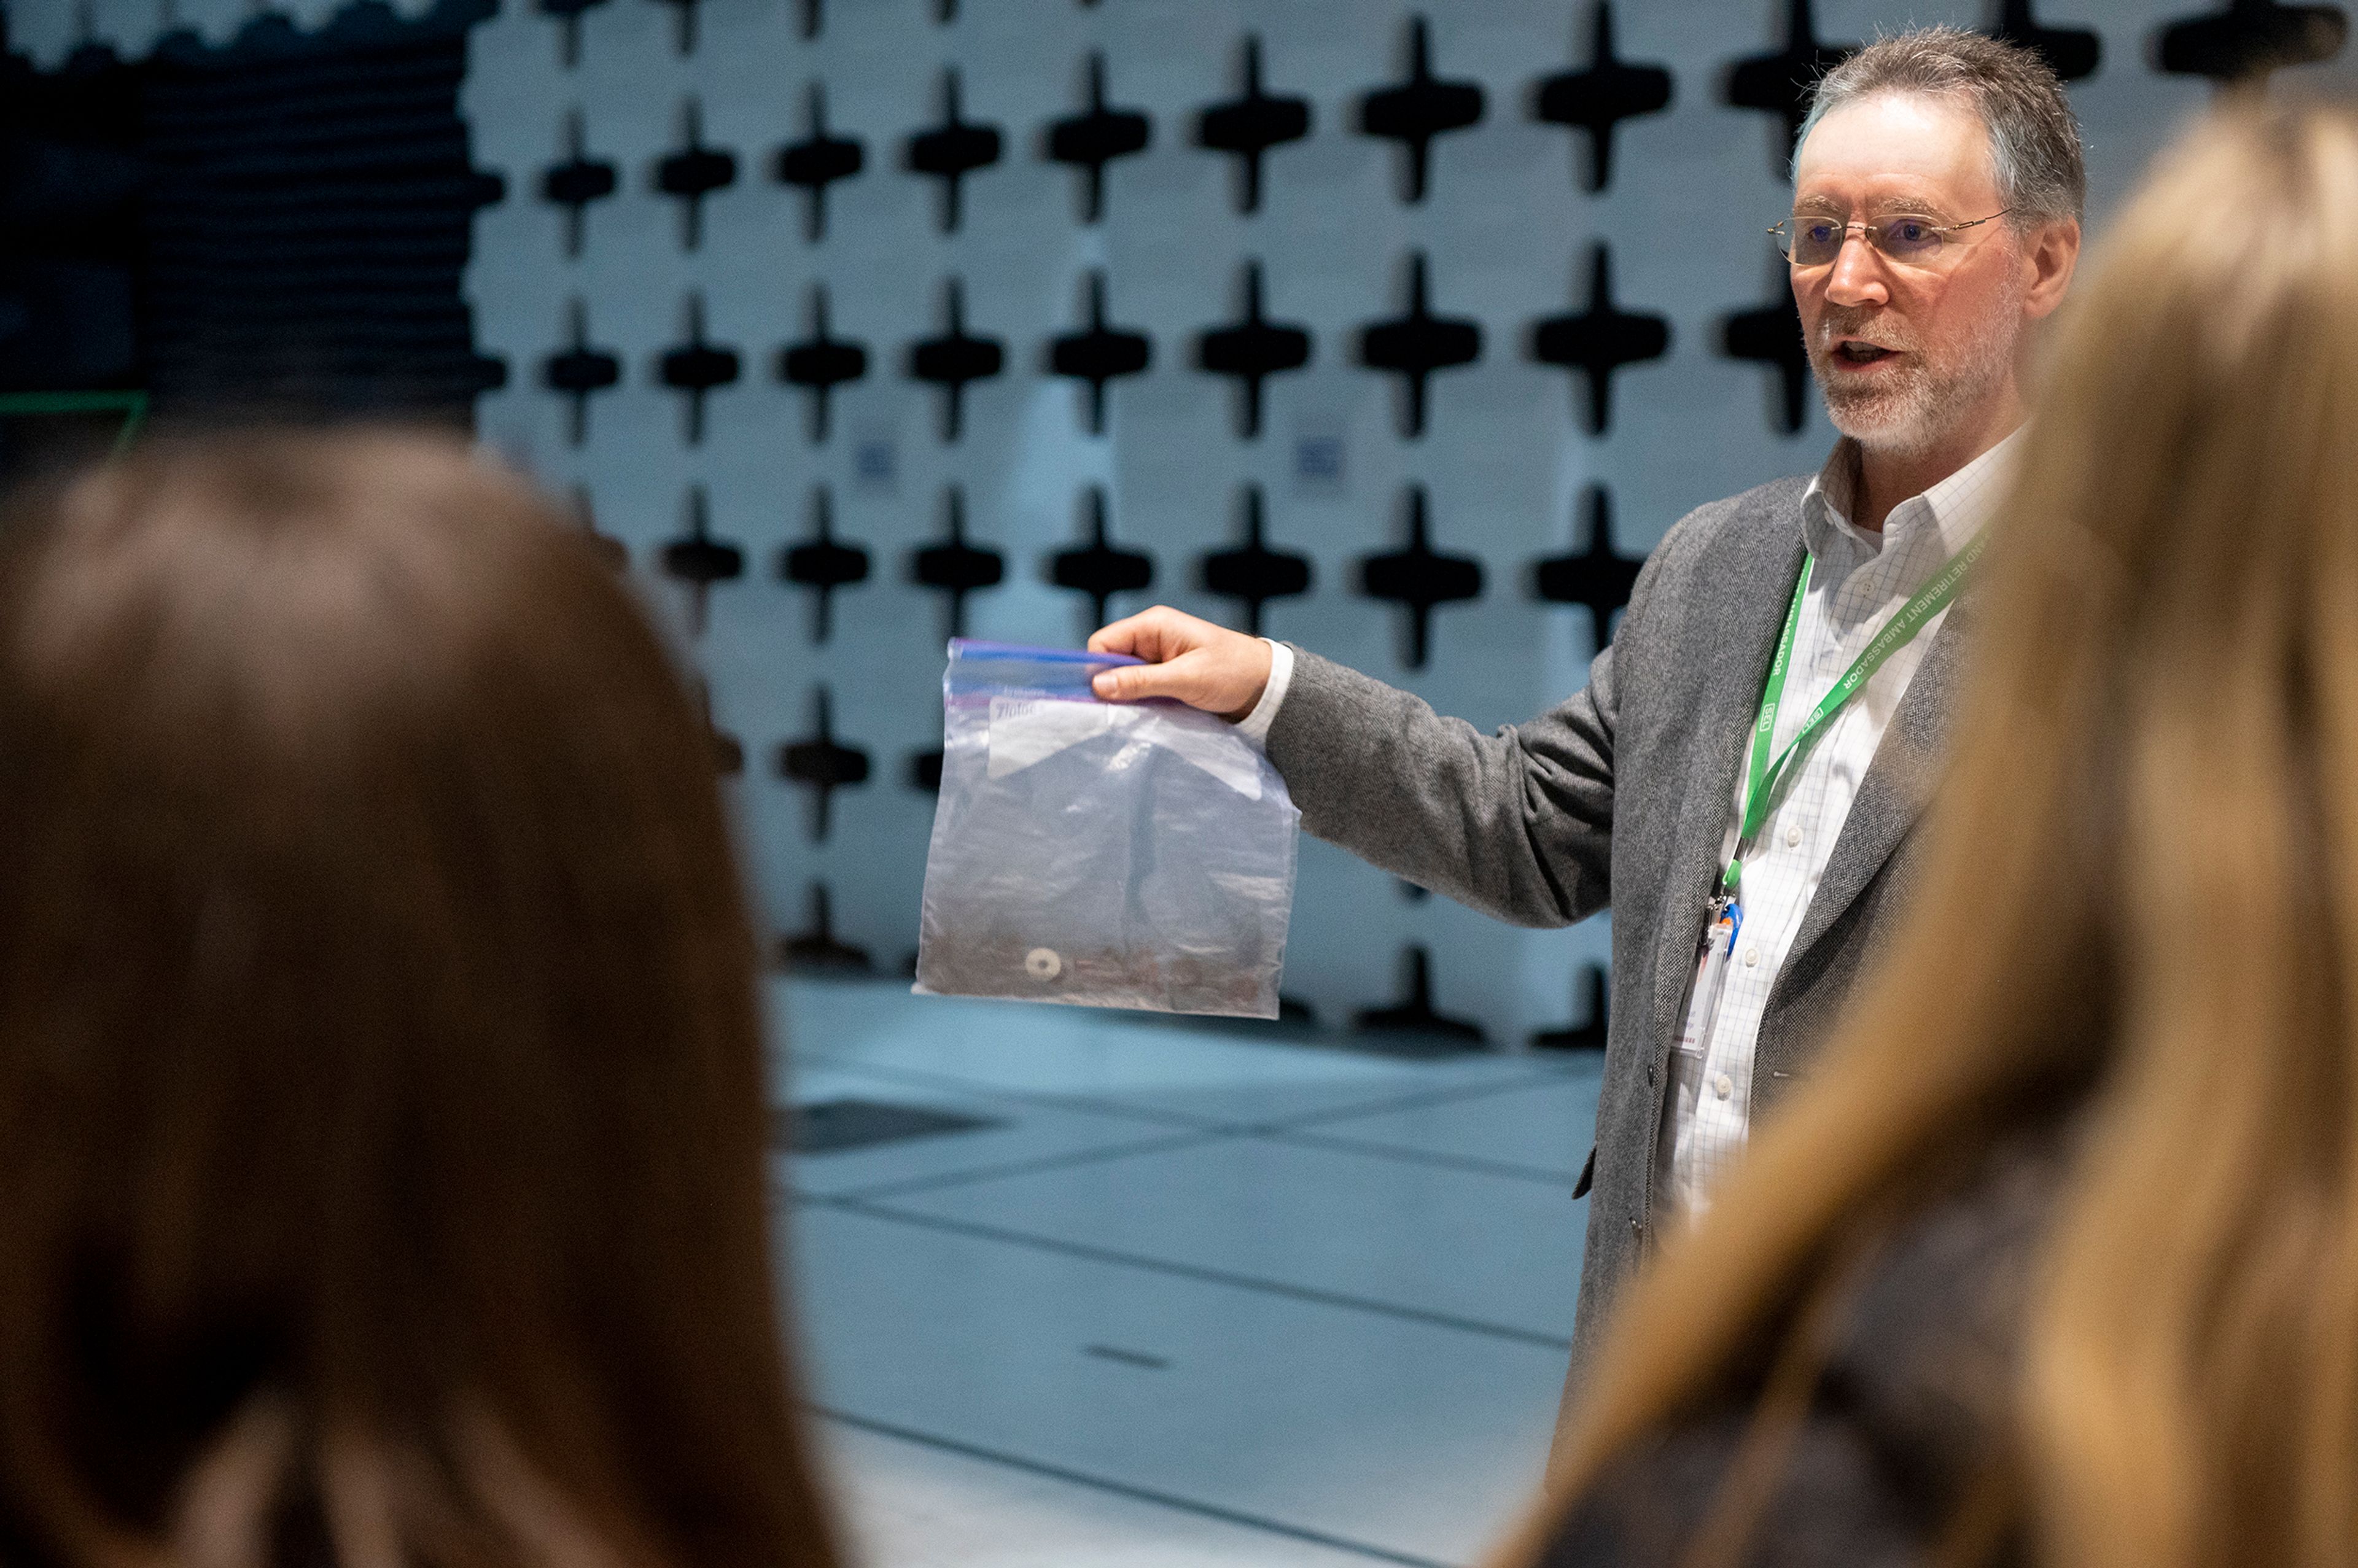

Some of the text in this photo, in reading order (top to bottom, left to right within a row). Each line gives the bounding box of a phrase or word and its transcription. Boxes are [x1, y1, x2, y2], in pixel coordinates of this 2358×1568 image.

[1905, 561, 1967, 623] RETIREMENT
[1843, 619, 1907, 691] AMBASSADOR
[1762, 706, 1773, 729] SEL
